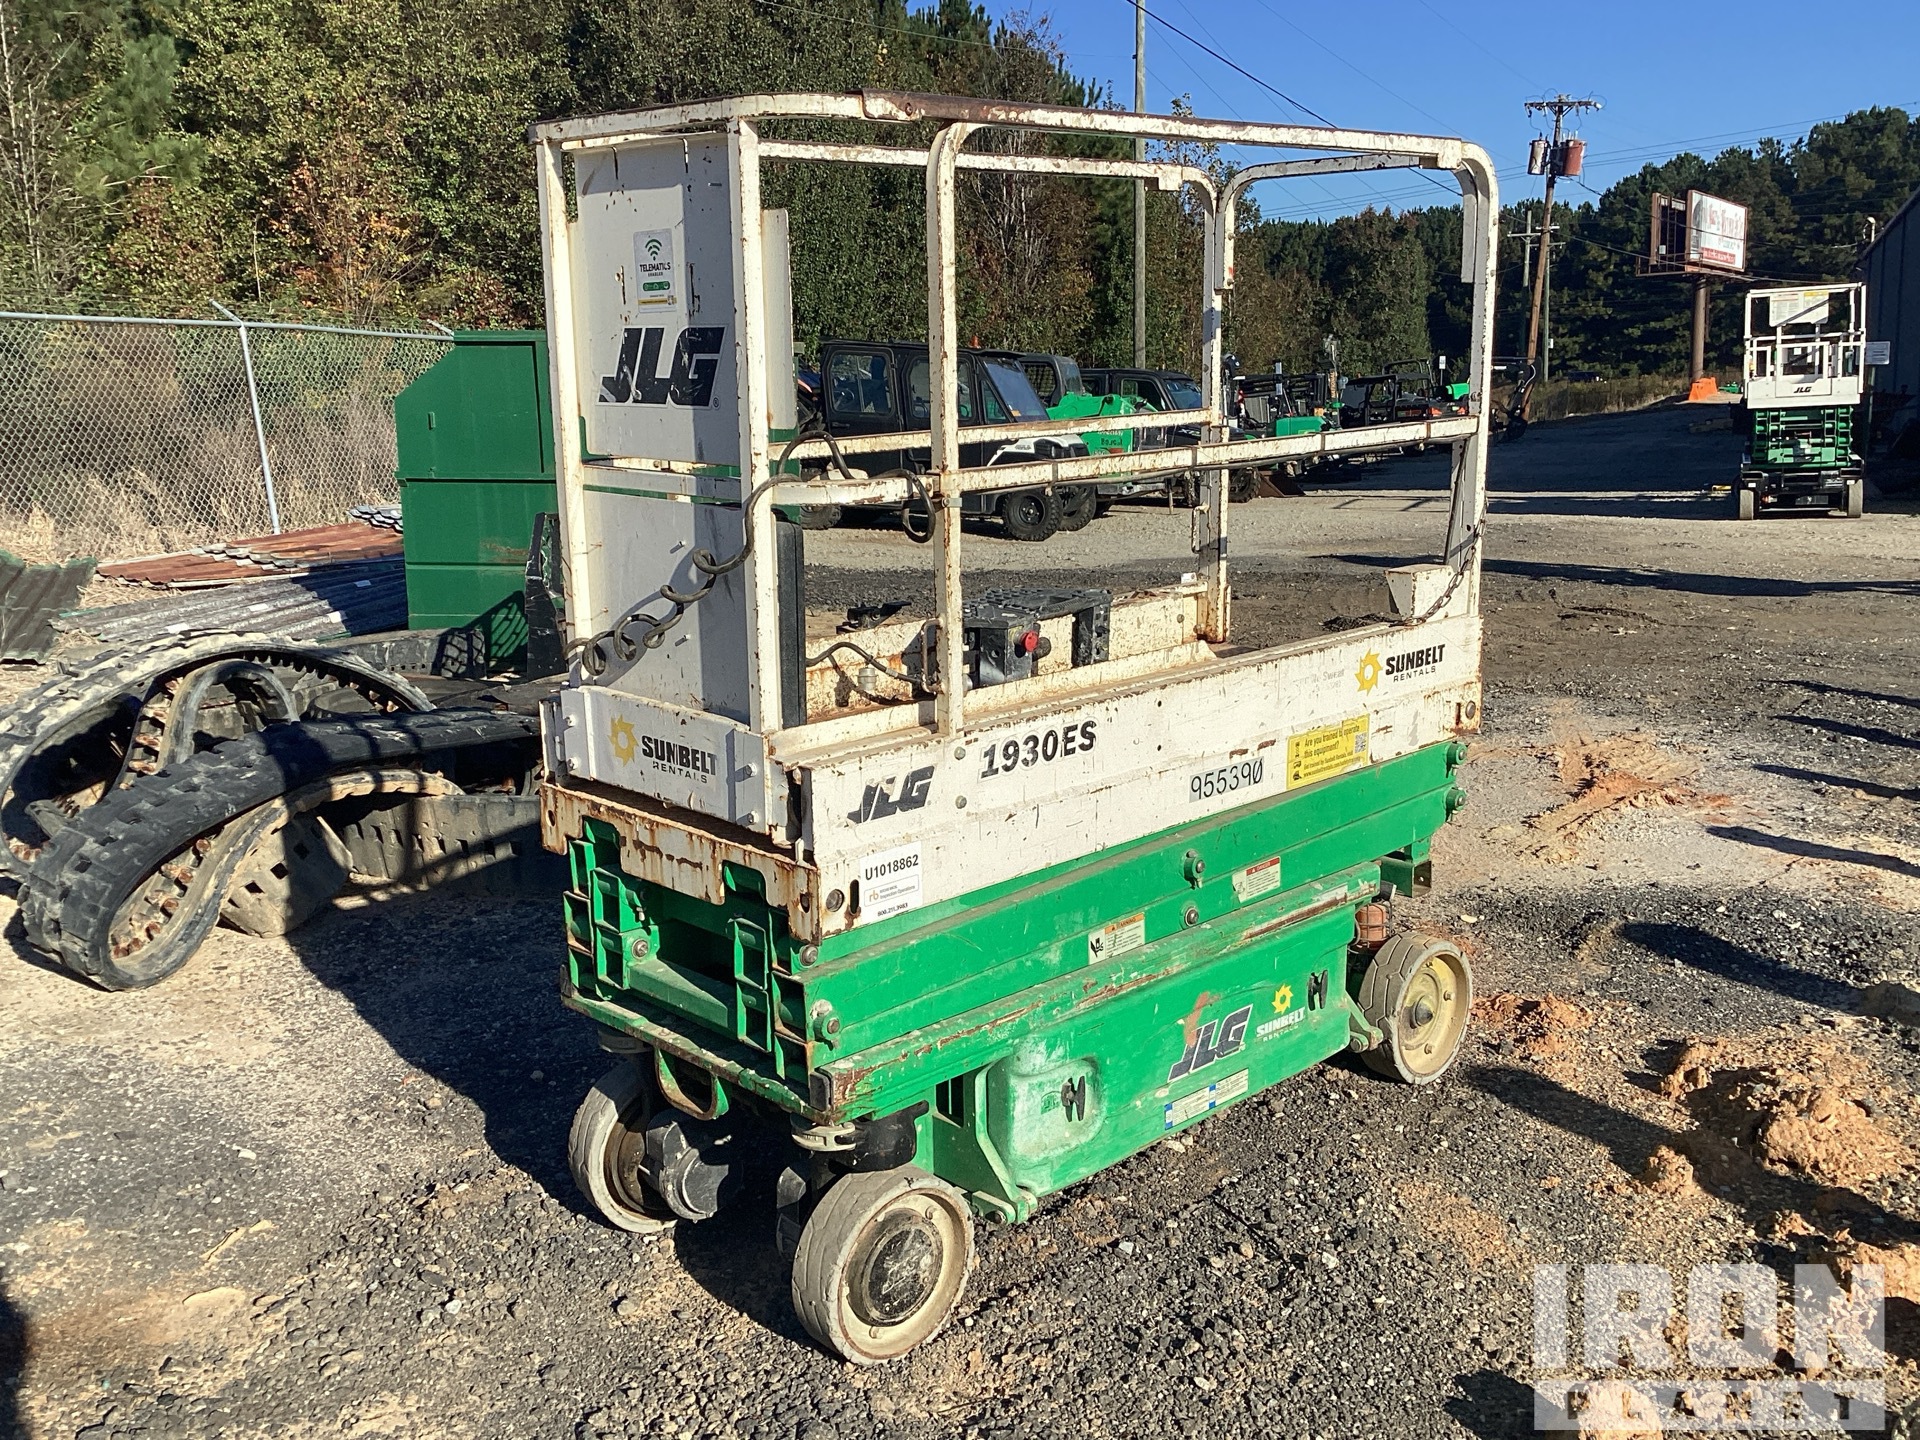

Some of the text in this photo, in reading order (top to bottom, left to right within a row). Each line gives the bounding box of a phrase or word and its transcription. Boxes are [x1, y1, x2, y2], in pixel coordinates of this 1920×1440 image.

[639, 262, 671, 272] TELEMATICS
[598, 326, 727, 407] JLG
[1793, 386, 1812, 394] JLG
[1385, 644, 1446, 676] SUNBELT
[1393, 665, 1437, 683] RENTALS
[641, 735, 718, 776] SUNBELT
[980, 720, 1098, 779] 1930ES
[1304, 738, 1313, 748] Are
[1313, 737, 1322, 747] you
[1304, 749, 1313, 759] this
[652, 761, 708, 784] RENTALS
[1190, 757, 1264, 800] 955390
[846, 764, 936, 825] JLG
[865, 854, 919, 881] U1018862
[1256, 1006, 1306, 1038] SUNBELT
[1168, 1003, 1253, 1082] JLG
